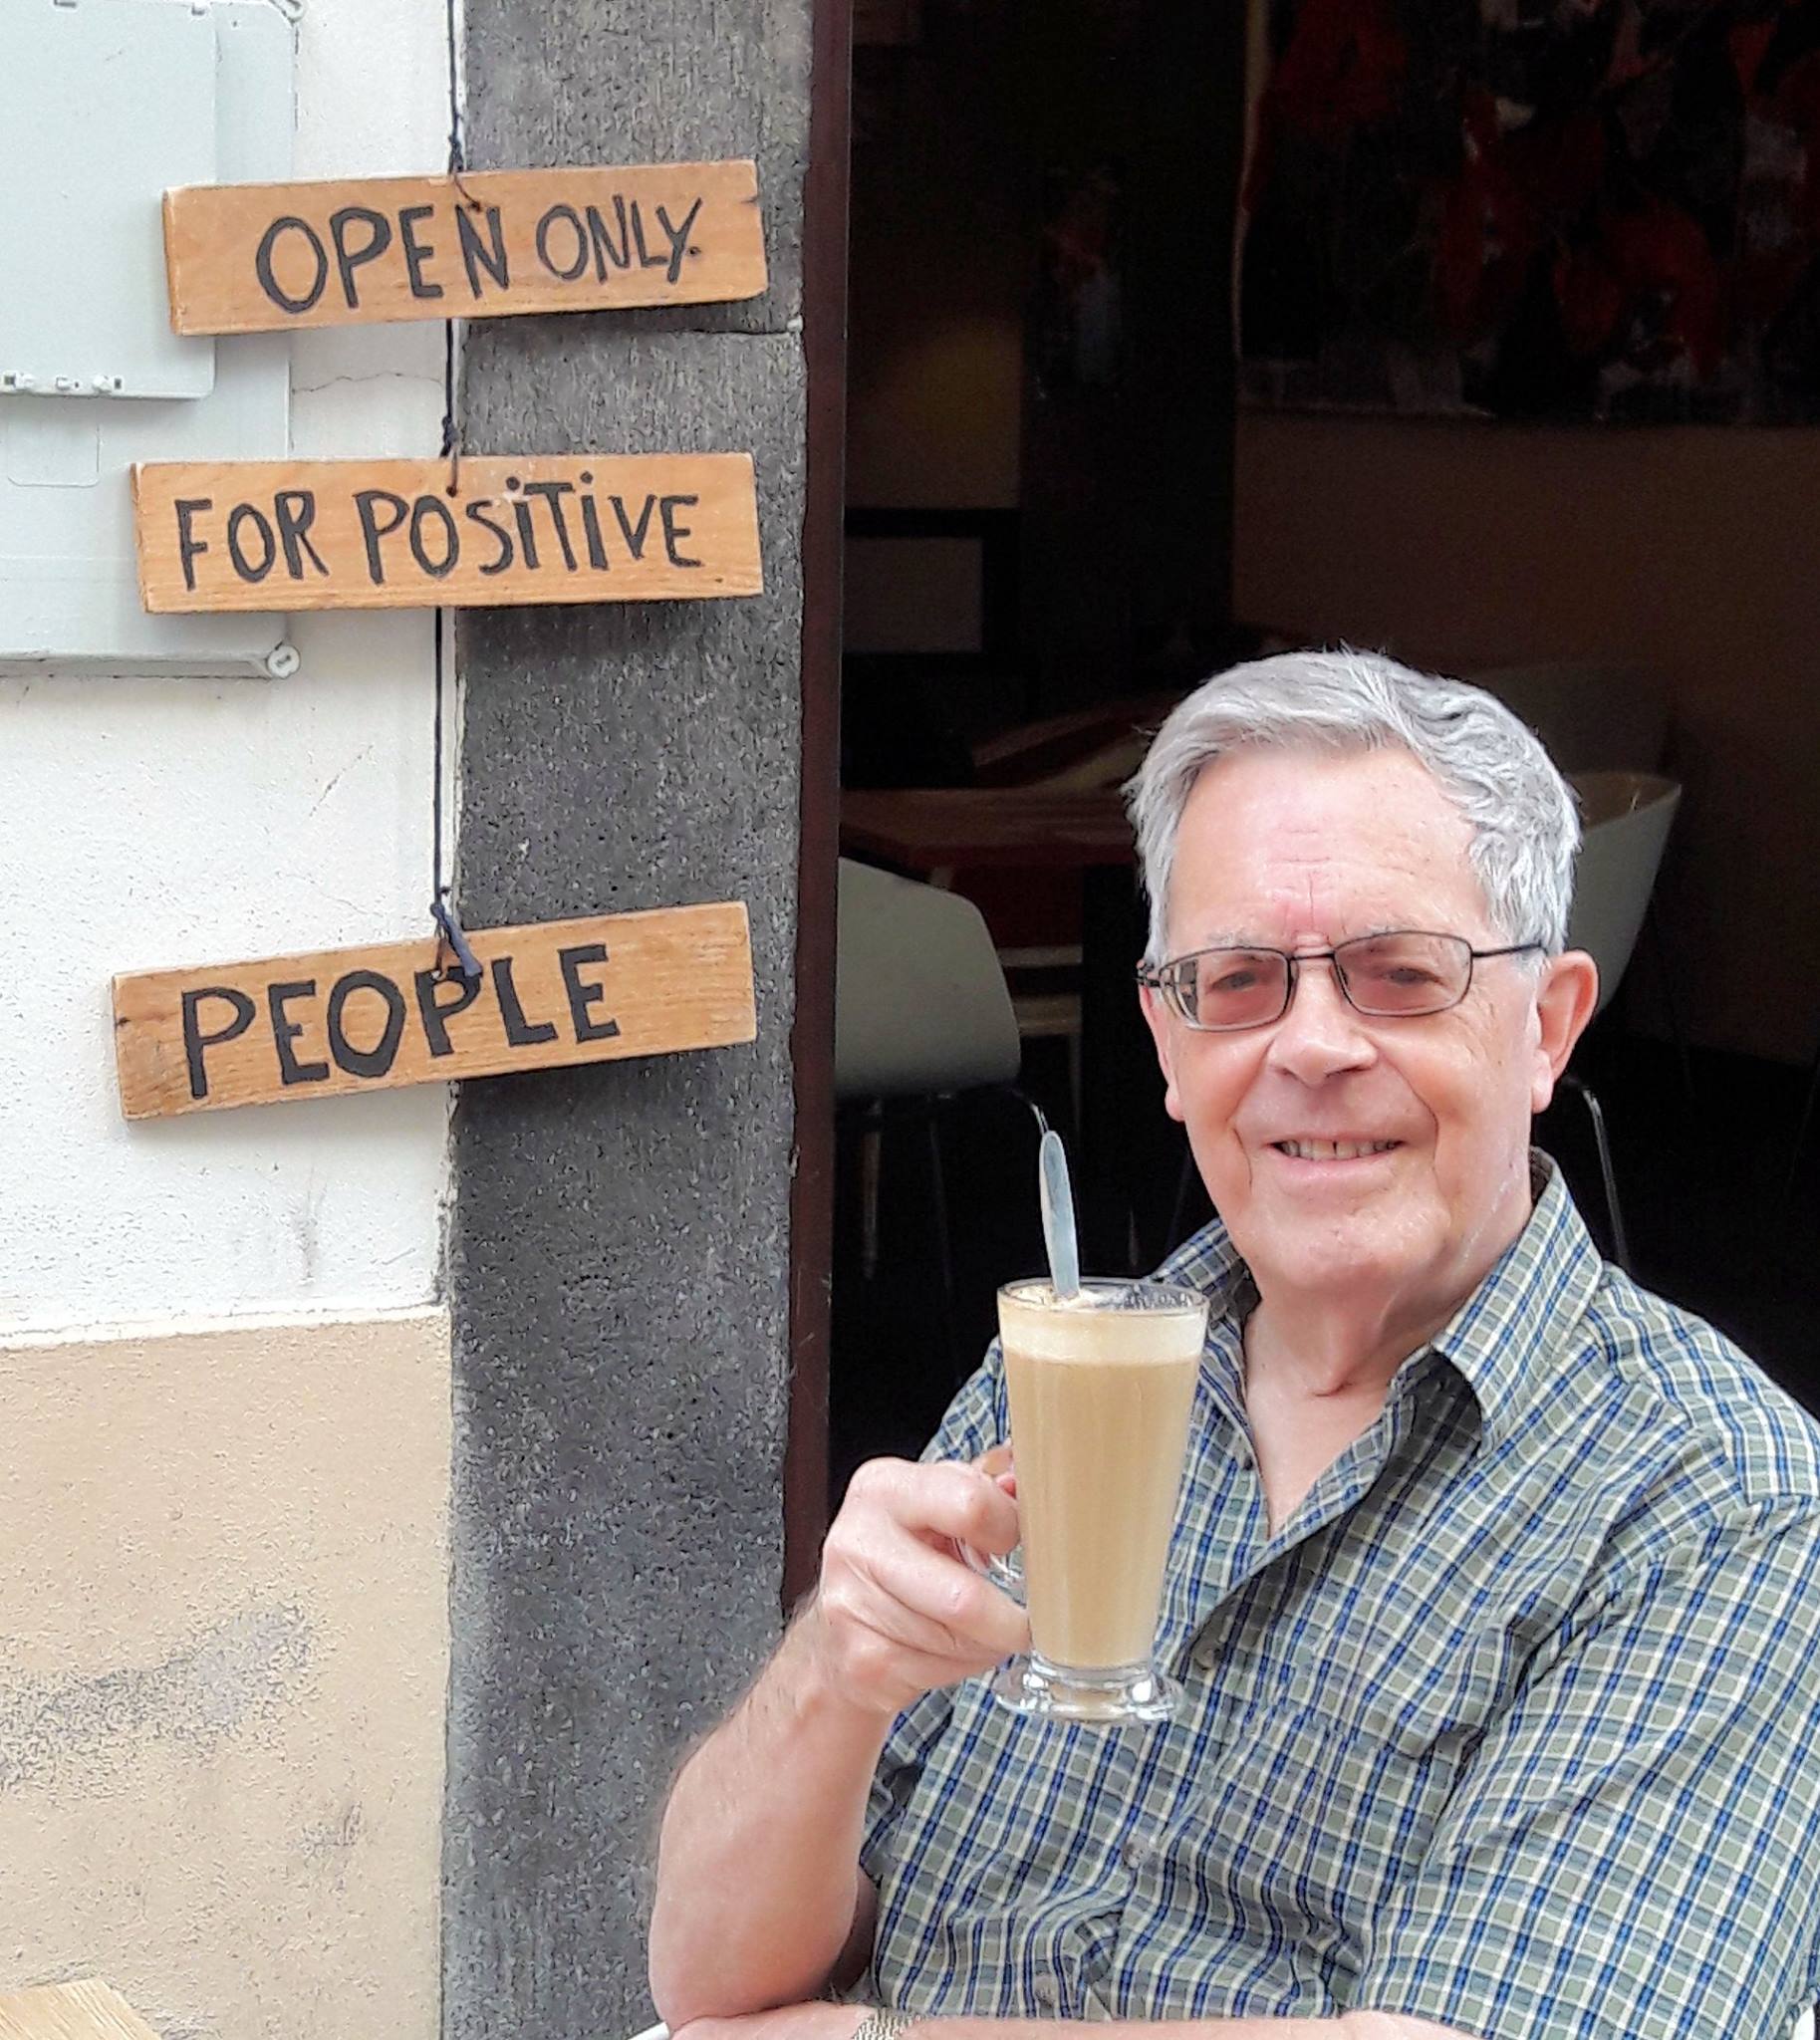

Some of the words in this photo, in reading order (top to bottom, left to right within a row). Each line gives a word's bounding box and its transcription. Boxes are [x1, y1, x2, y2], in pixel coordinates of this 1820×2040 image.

[256, 203, 509, 314] OPEN
[535, 193, 702, 285] ONLY
[174, 490, 330, 591] FOR
[181, 943, 620, 1099] PEOPLE
